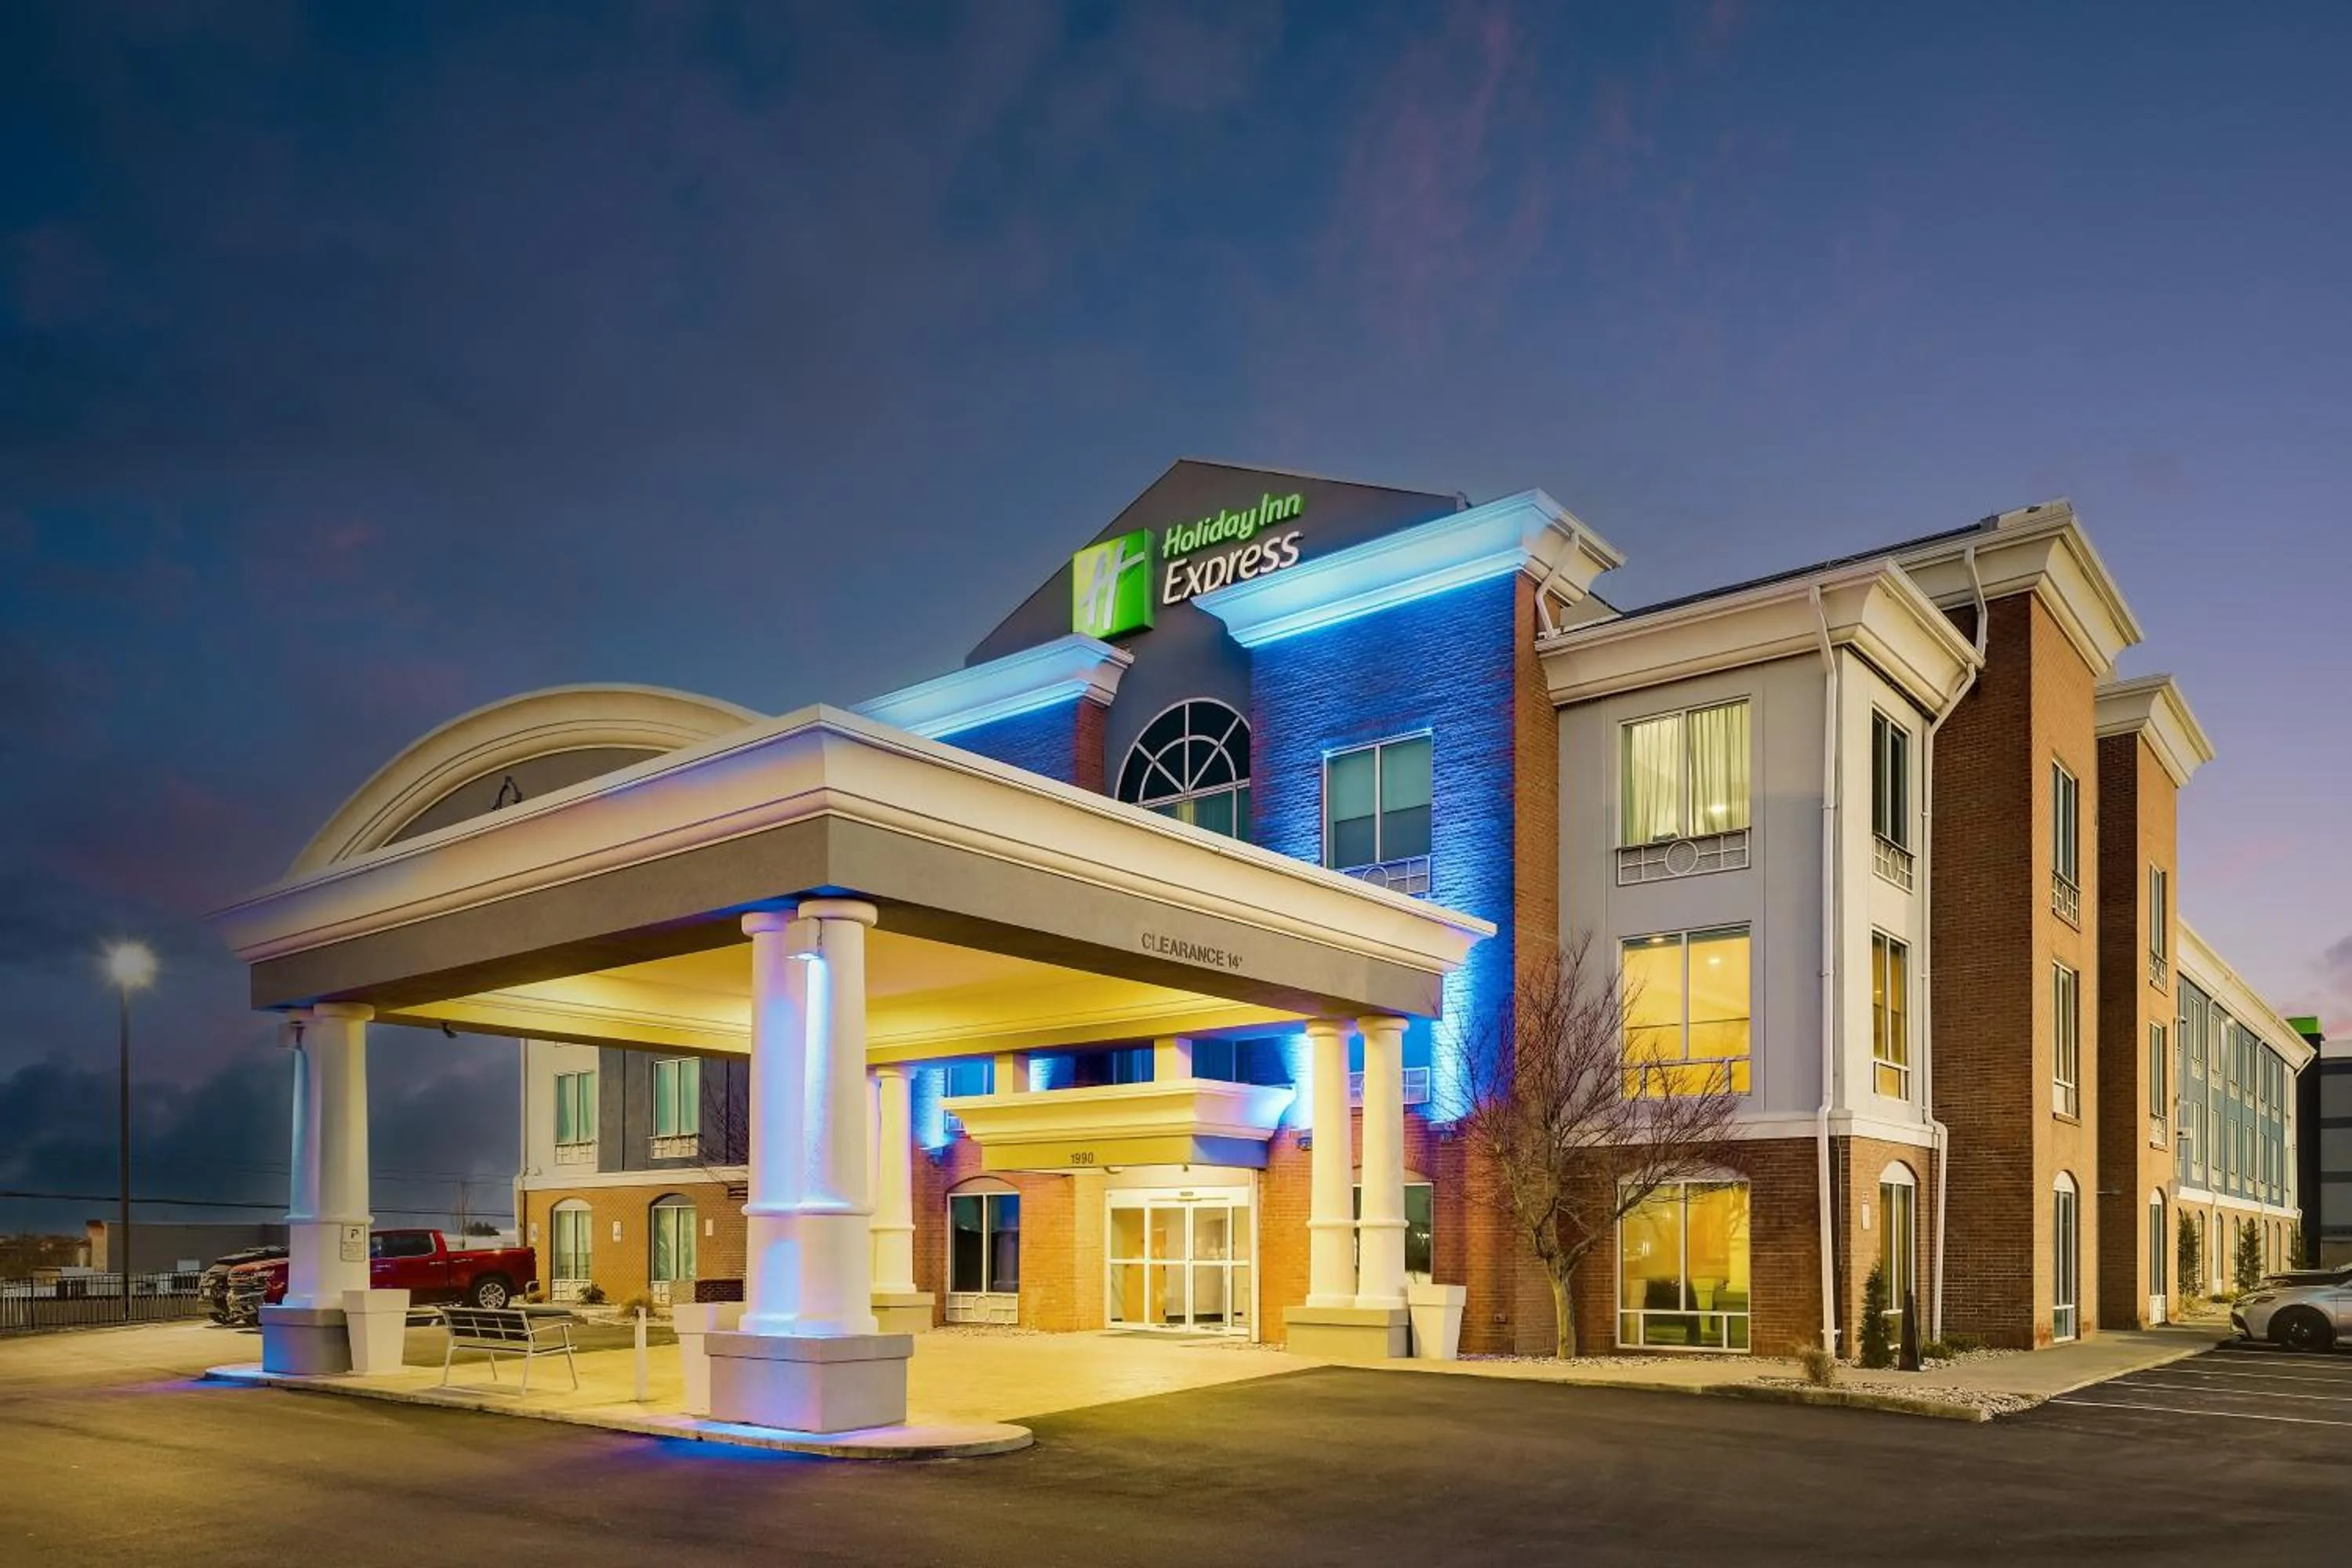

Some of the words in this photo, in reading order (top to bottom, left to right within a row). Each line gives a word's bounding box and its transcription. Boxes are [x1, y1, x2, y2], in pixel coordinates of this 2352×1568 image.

[1163, 507, 1257, 558] Holiday
[1258, 492, 1301, 526] Inn
[1163, 531, 1300, 604] Express
[1141, 932, 1225, 967] CLEARANCE
[1070, 1152, 1094, 1164] 1990
